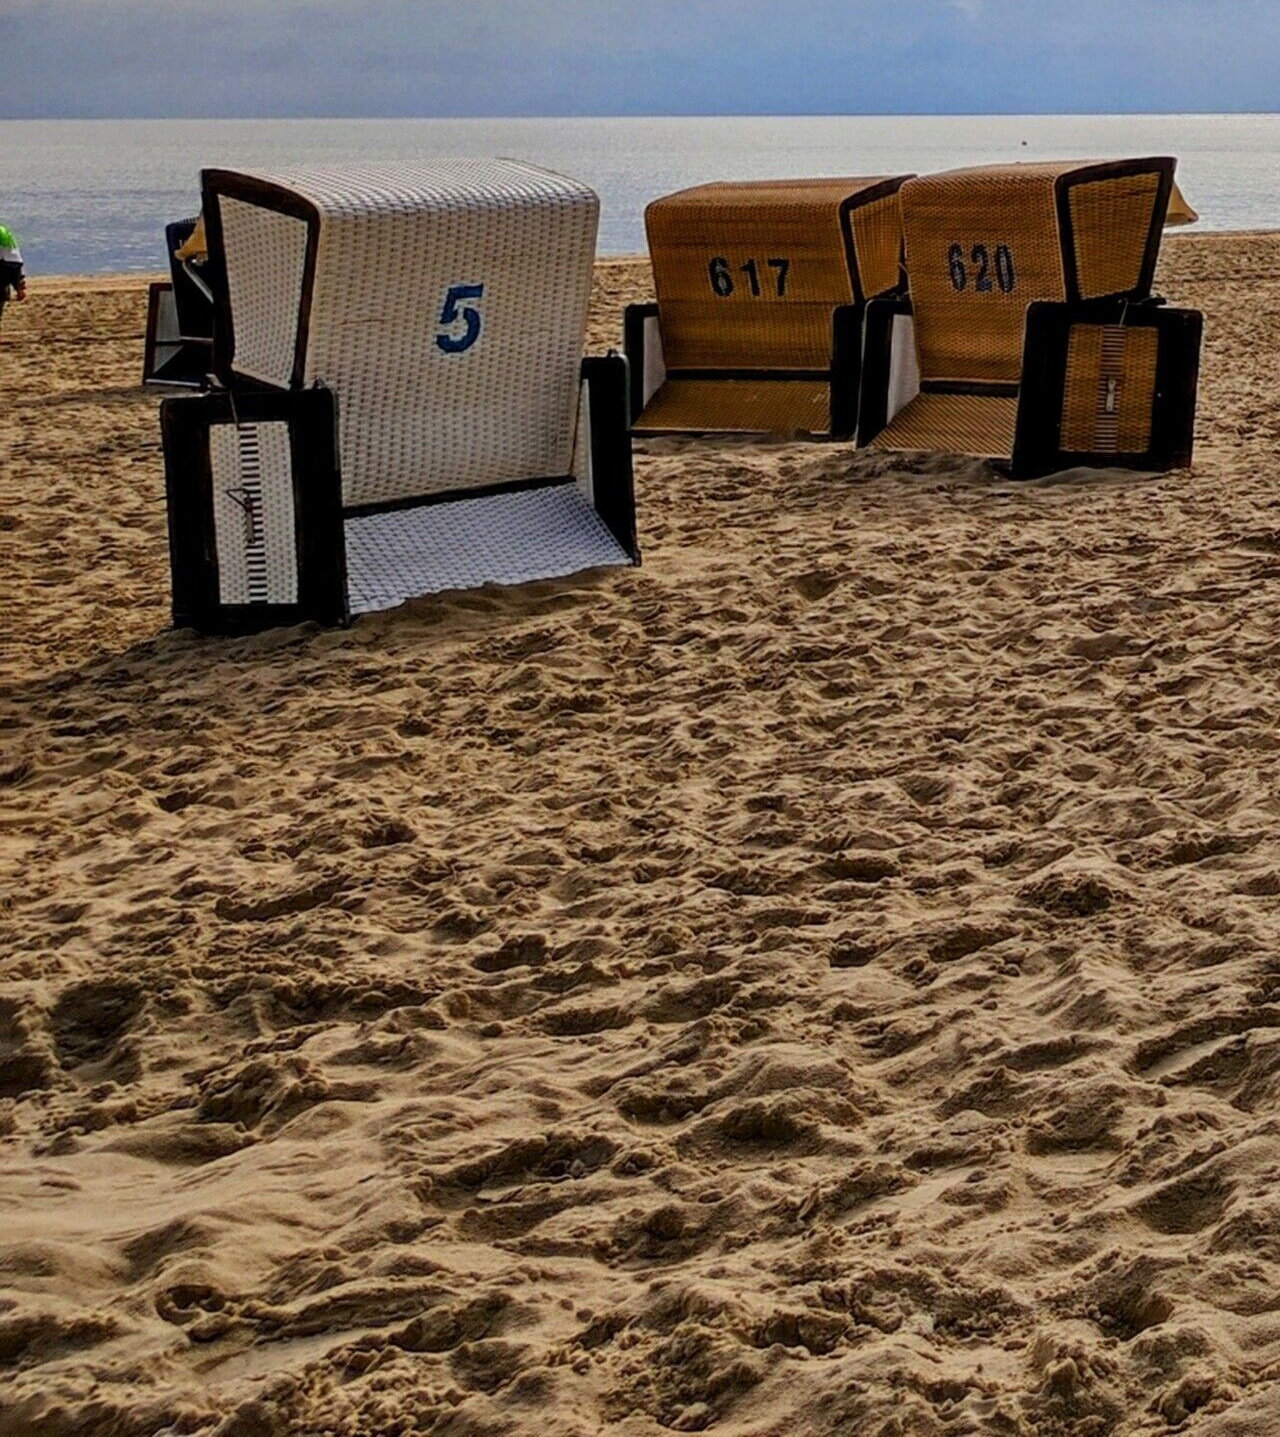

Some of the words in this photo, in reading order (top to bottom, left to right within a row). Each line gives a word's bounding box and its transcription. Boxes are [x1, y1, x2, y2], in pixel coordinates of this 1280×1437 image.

[709, 257, 789, 297] 617
[948, 244, 1016, 293] 620
[436, 283, 484, 353] 5
